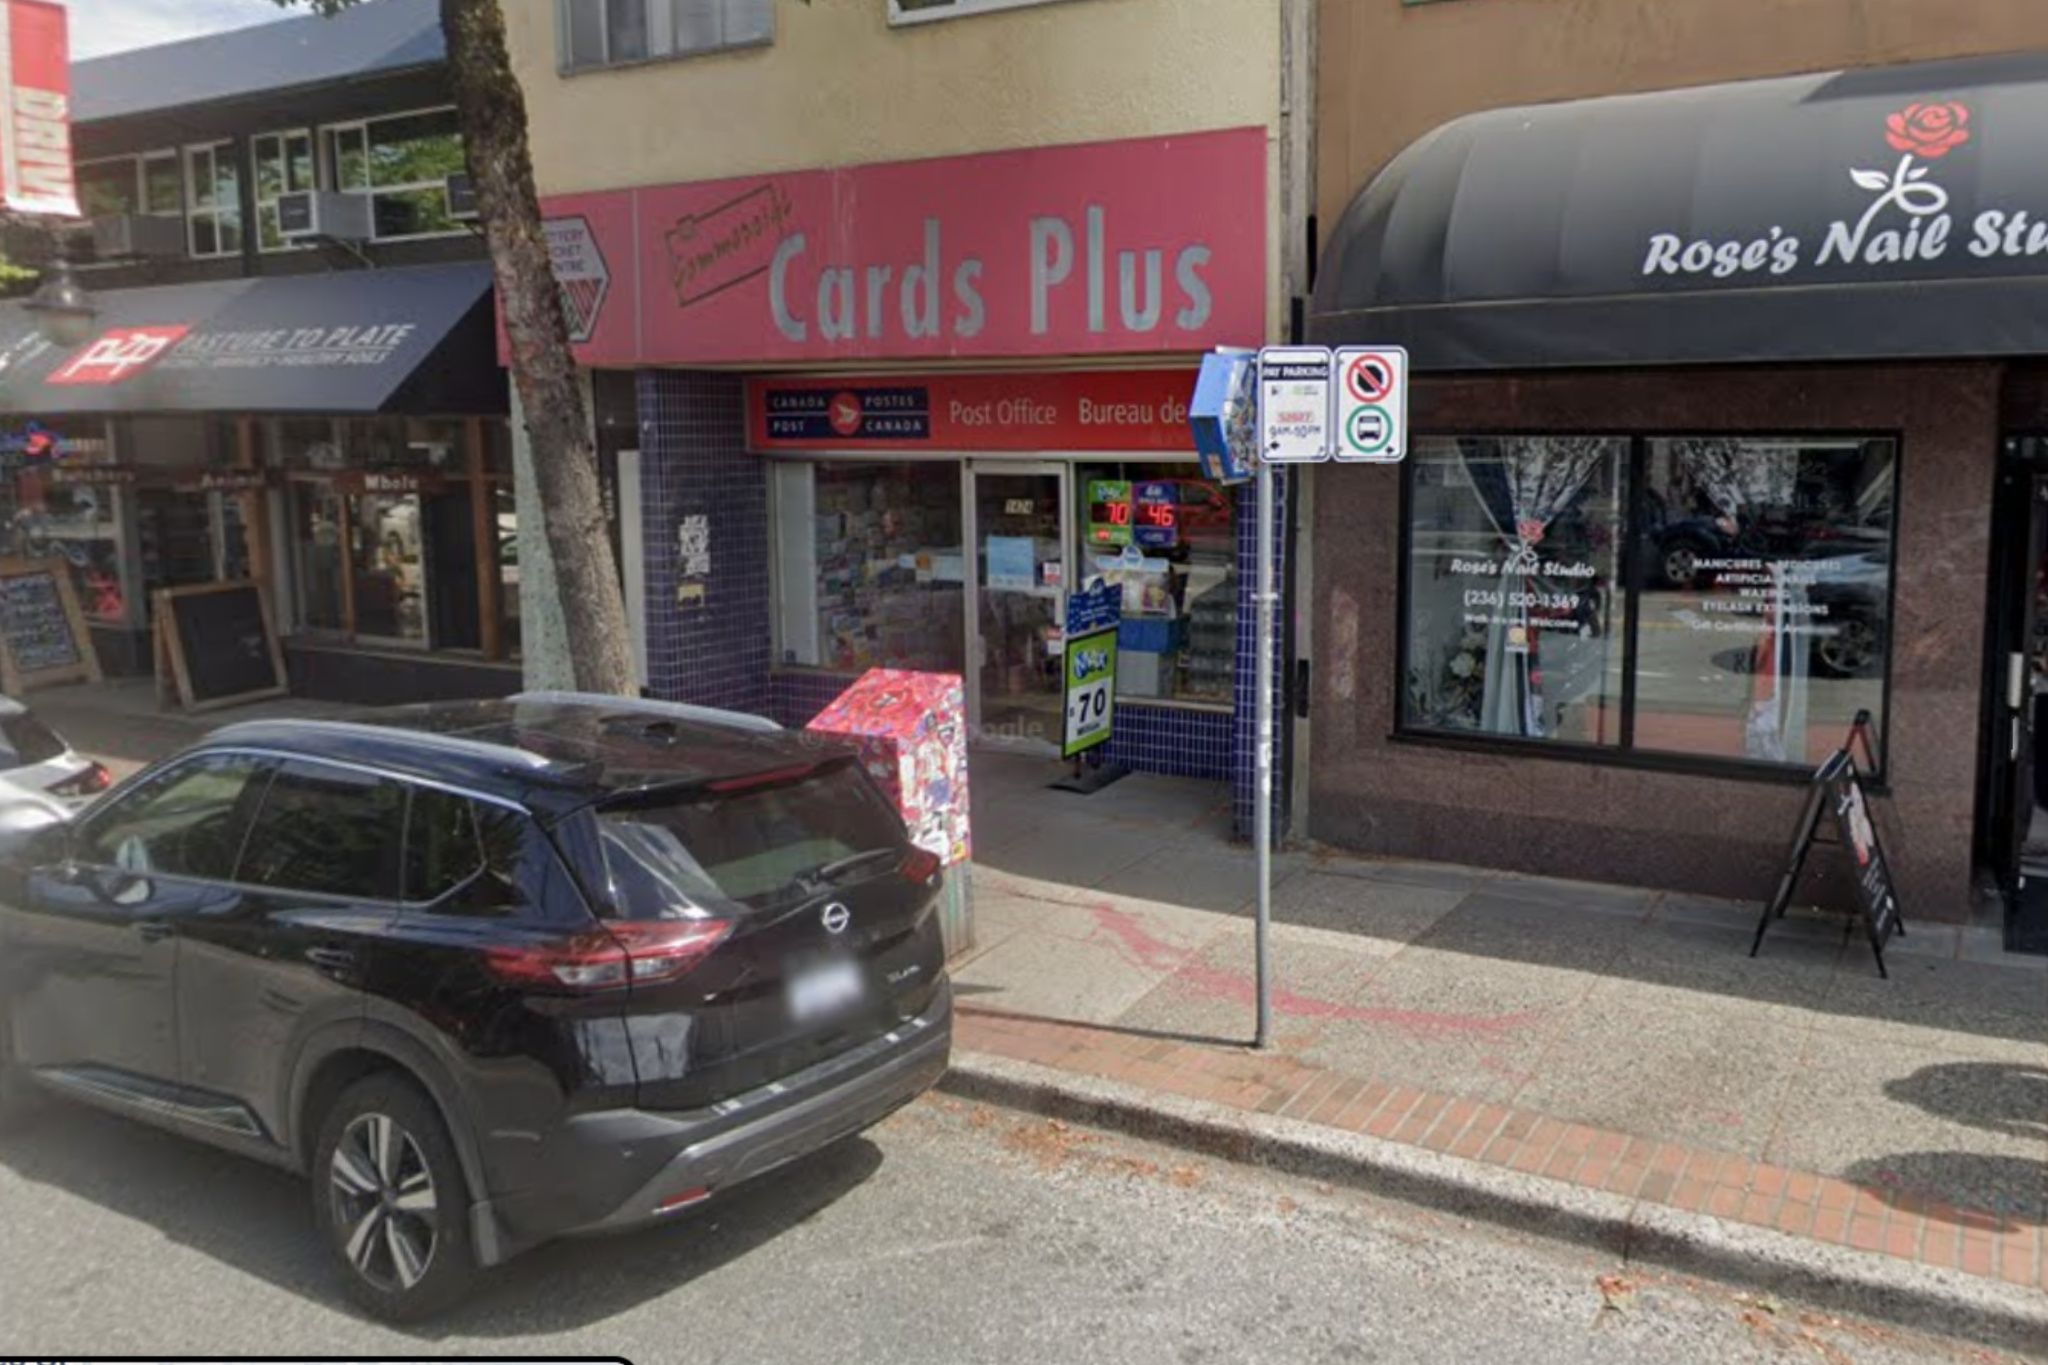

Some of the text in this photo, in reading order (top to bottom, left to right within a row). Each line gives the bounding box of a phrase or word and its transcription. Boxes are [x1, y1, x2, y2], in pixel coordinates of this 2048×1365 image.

[1642, 224, 1799, 278] Rose's
[1814, 213, 1952, 265] Nail
[769, 205, 1212, 343] Cards Plus
[282, 327, 324, 350] TO
[322, 323, 416, 347] PLATE
[772, 396, 826, 409] CANADA
[864, 394, 915, 408] POSTES
[950, 396, 1187, 425] Post Office Bureau de
[772, 420, 805, 433] POST
[864, 419, 923, 432] CANADA
[1106, 502, 1130, 527] 70
[1148, 503, 1175, 527] 46
[1450, 558, 1498, 574] Rose's
[1543, 560, 1596, 577] Studio
[1715, 573, 1777, 583] ARTIFICIA
[1463, 588, 1504, 609] (236)
[1755, 603, 1829, 616] EXTNSIONS
